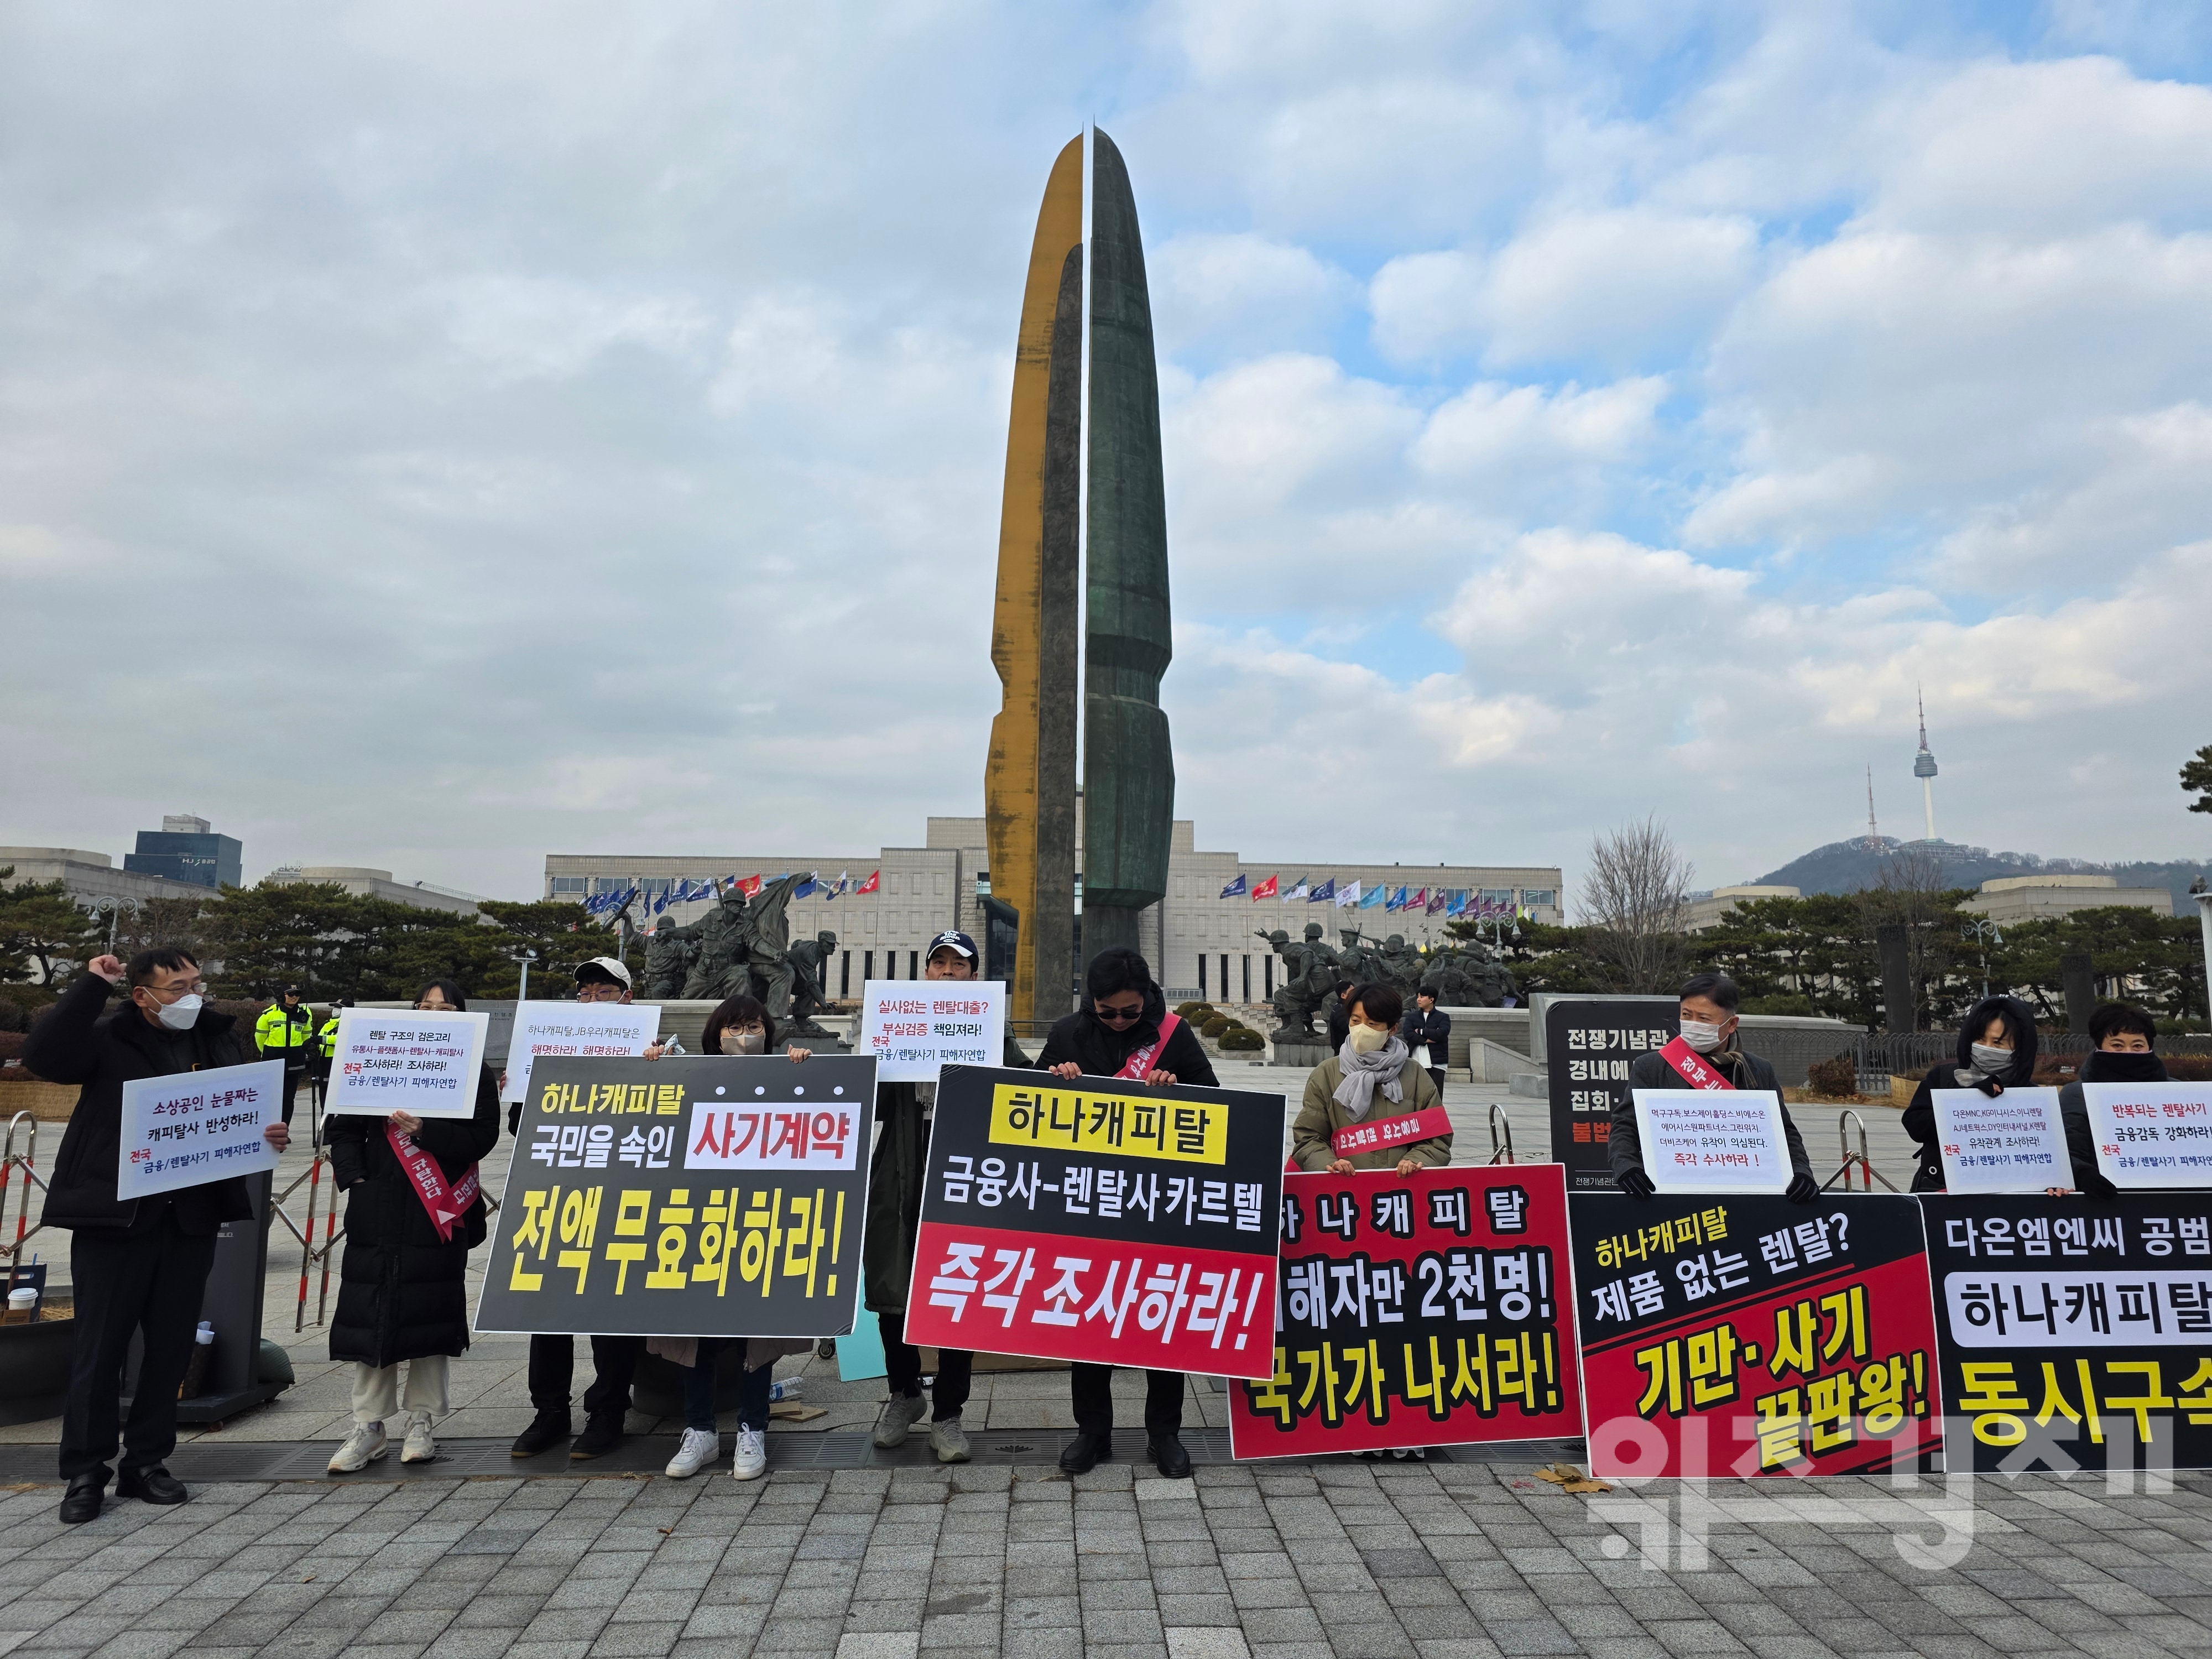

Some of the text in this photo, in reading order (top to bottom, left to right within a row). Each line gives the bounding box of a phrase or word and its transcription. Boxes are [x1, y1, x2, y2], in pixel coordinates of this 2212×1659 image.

[879, 1000, 989, 1015] 실사없는 렌탈대출?
[370, 1030, 451, 1042] 렌탈 구조의 검은고리
[528, 1025, 640, 1039] 하나캐피탈,JB우리캐피탈은
[882, 1023, 982, 1037] 부실검증 책임져라!
[872, 1036, 890, 1047] 전국
[1568, 1029, 1669, 1050] 전쟁기념관
[351, 1045, 464, 1057] 유통사-플랫폼사-렌탈사-캐피탈사
[531, 1044, 631, 1056] 해명하라! 해명하라!
[875, 1048, 985, 1061] 금융/렌탈사기 피해자연합
[343, 1063, 362, 1074] 전국
[363, 1059, 447, 1072] 조사하라! 조사하라!
[1569, 1060, 1635, 1081] 경내에
[348, 1076, 457, 1089] 금융/렌탈사기 피해자연합
[153, 1087, 258, 1116] 소상공인 눈물짜는
[541, 1083, 685, 1116] 하나캐피탈
[1953, 1108, 2043, 1119] 다온MNC,KG이니시스,이니렌탈
[2112, 1103, 2207, 1118] 반복되는 렌탈사기
[148, 1110, 258, 1141] 캐피탈사 반성하라!
[1009, 1093, 1211, 1155] 하나캐피탈
[1383, 1118, 1420, 1140] 금융사와
[693, 1112, 850, 1160] 사기계약
[1340, 1127, 1377, 1149] 렌탈사의
[2115, 1126, 2212, 1141] 금융감독 강화하라!
[531, 1124, 675, 1168] 국민을 속인
[1660, 1138, 1768, 1149] 더비즈케어 유착이 의심된다.
[1944, 1144, 1960, 1156] 전국
[1969, 1136, 2041, 1149] 유착관계 조사하라!
[2102, 1145, 2120, 1156] 전국
[130, 1148, 152, 1164] 전국
[143, 1141, 261, 1173] 금융/렌탈사기 피해자연합
[1674, 1153, 1697, 1166] 즉각
[1703, 1154, 1749, 1167] 수사하라
[1959, 1153, 2052, 1166] 금융/렌탈사기 피해자연합
[2119, 1156, 2176, 1167] 금융/렌탈사기
[411, 1158, 442, 1199] 규탄한다
[509, 1185, 845, 1298] 전액 무효화하라!
[1595, 1205, 1728, 1269] 하나캐피탈
[1945, 1217, 2211, 1256] 다온엠엔씨 공범
[1591, 1212, 1849, 1322] 제품 없는 렌탈?
[1418, 1251, 1551, 1322] 2천명!
[928, 1242, 1264, 1351] 즉각 조사하라!
[1960, 1281, 2212, 1335] 하나캐피탈
[1250, 1332, 1557, 1424] 국가가 나서라!
[1756, 1353, 1927, 1468] 끝판왕!
